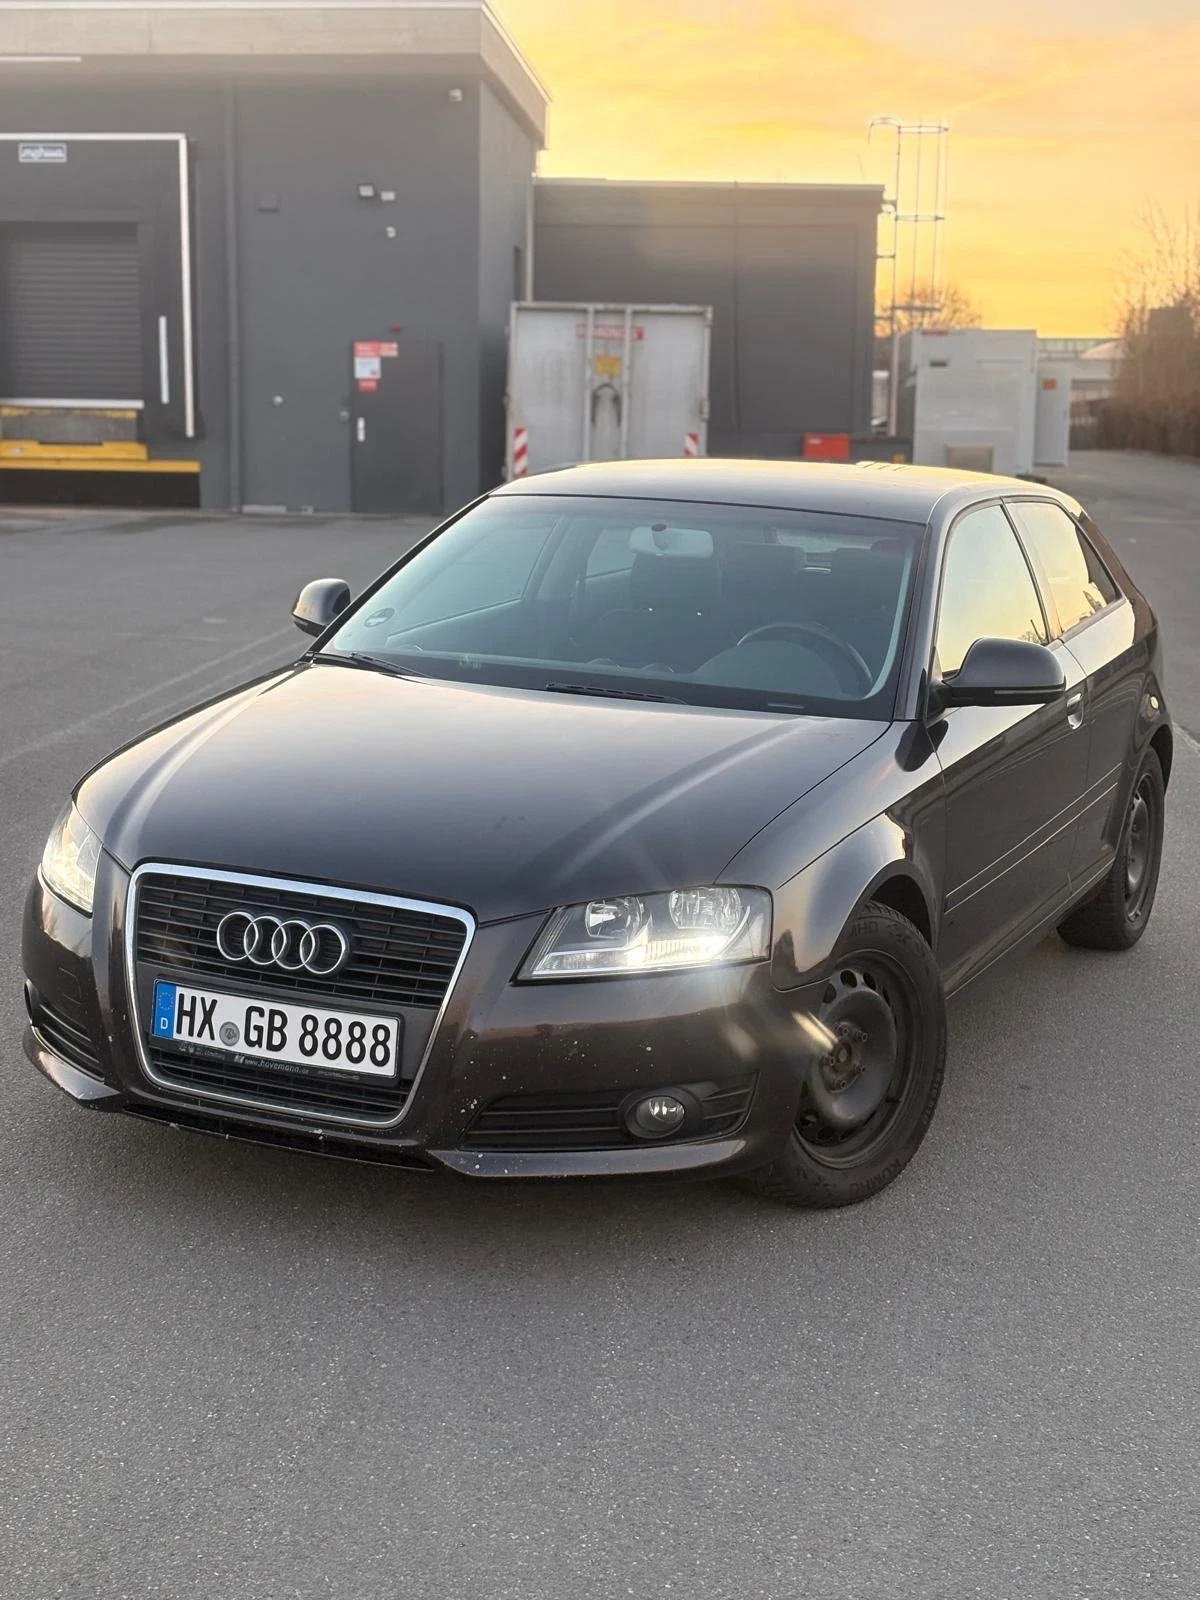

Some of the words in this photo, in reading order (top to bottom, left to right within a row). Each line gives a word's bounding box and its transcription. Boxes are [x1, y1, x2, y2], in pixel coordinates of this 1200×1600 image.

[160, 1017, 169, 1030] D
[176, 993, 218, 1041] HX
[244, 1006, 288, 1052] GB
[298, 1014, 391, 1067] 8888
